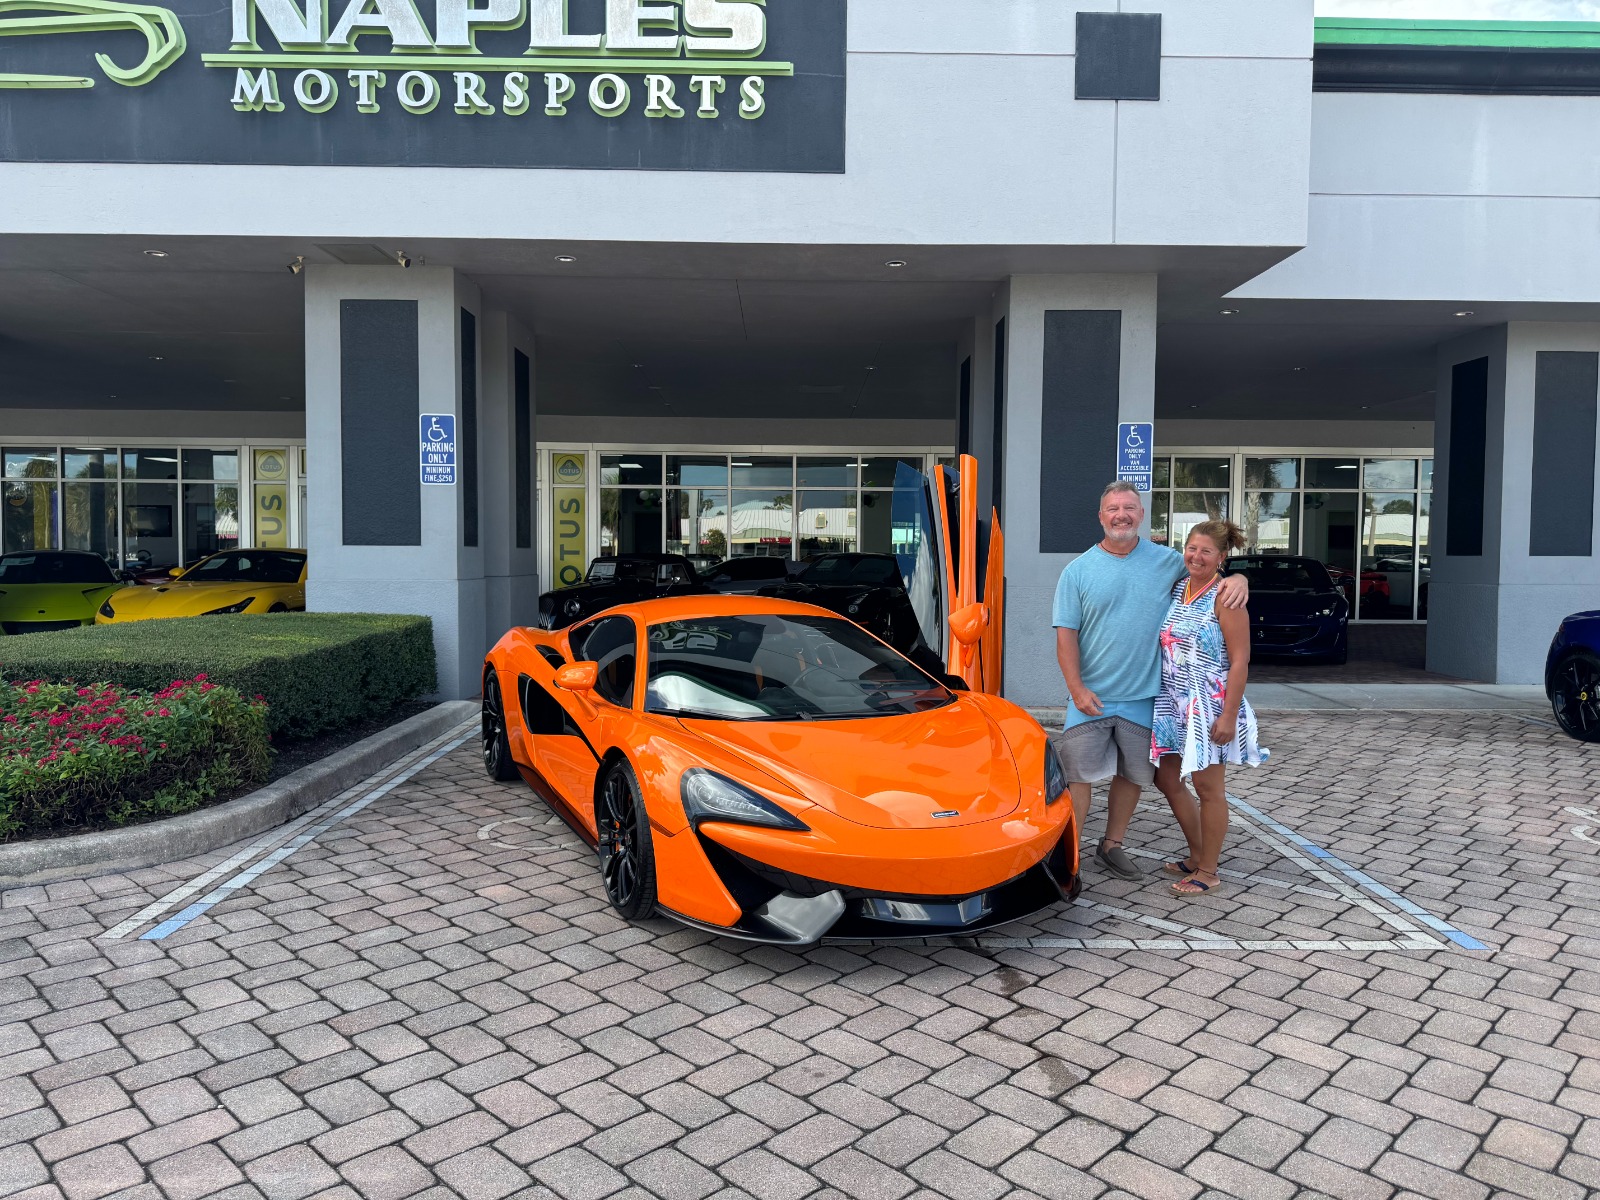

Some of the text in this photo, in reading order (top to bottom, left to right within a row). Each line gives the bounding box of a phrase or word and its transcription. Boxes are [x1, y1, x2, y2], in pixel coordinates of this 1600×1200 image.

[230, 0, 766, 57] NAPLES
[230, 67, 765, 119] MOTORSPORTS
[422, 442, 454, 452] PARKING
[428, 453, 448, 463] ONLY
[425, 466, 451, 474] MINIMUM
[424, 474, 453, 482] FINE $250
[260, 494, 283, 548] US
